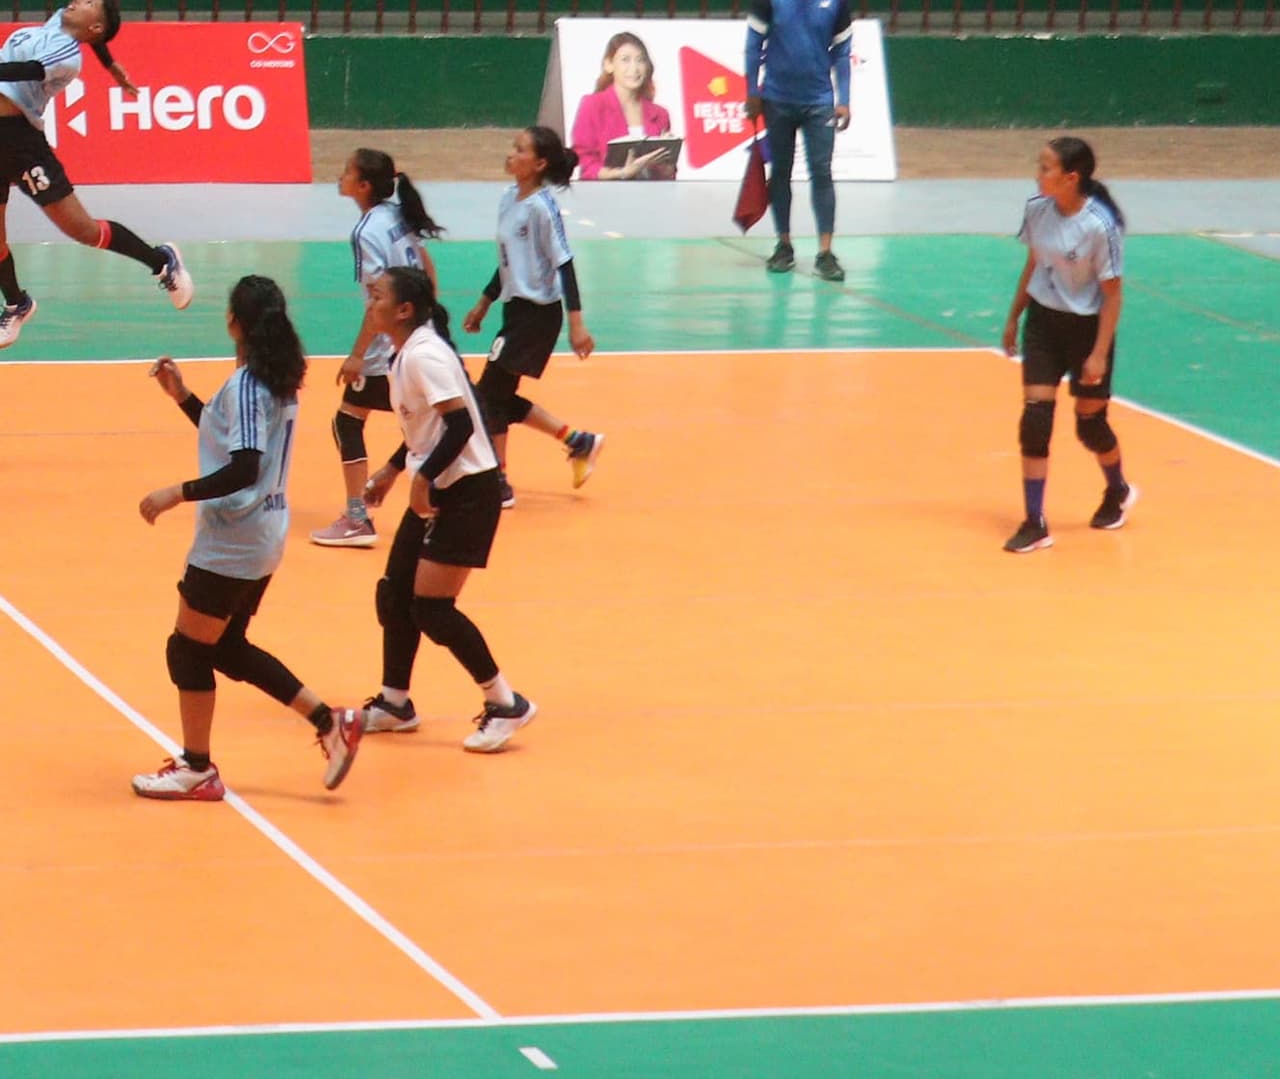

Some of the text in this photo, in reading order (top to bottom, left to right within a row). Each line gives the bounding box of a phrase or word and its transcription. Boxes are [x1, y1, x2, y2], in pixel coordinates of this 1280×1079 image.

[108, 84, 266, 132] Hero
[703, 119, 745, 134] PTE
[22, 166, 50, 195] 13
